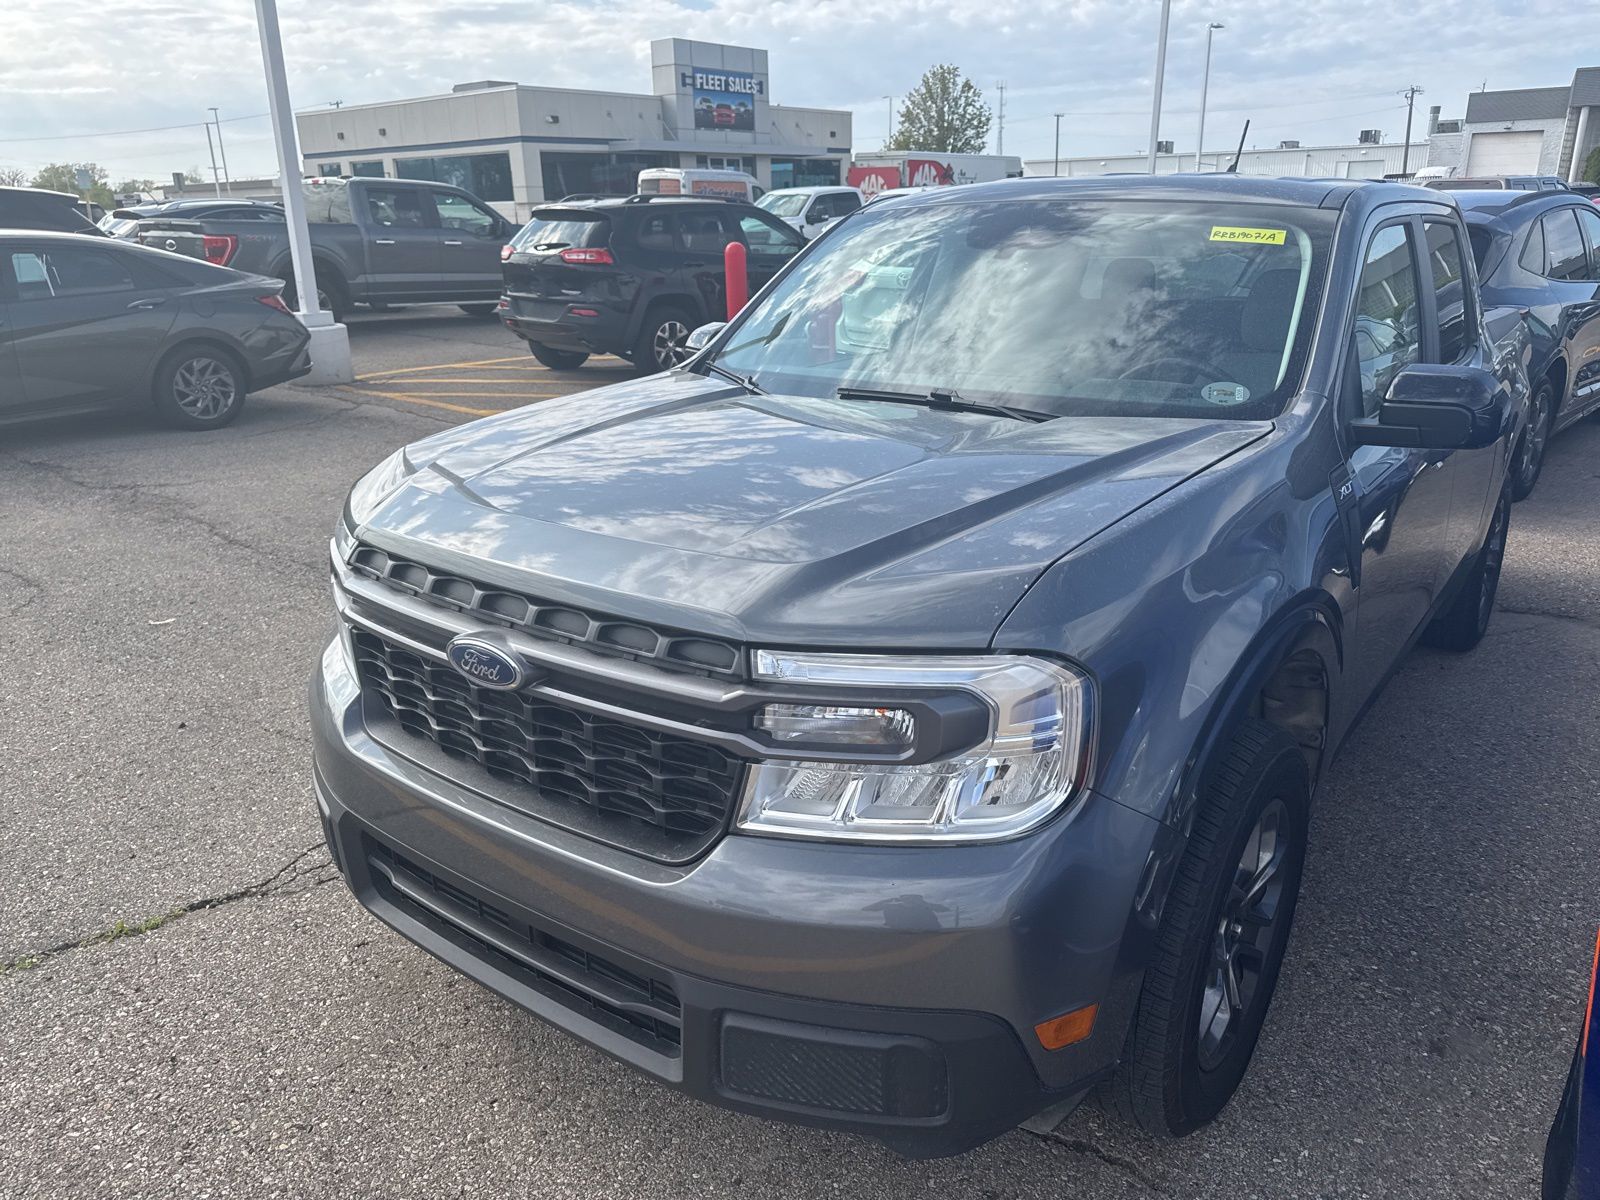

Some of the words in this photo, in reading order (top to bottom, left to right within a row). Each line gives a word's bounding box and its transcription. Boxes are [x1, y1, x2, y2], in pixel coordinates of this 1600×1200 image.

[695, 73, 726, 91] FLEET
[728, 76, 757, 94] SALES
[461, 648, 500, 681] Ford
